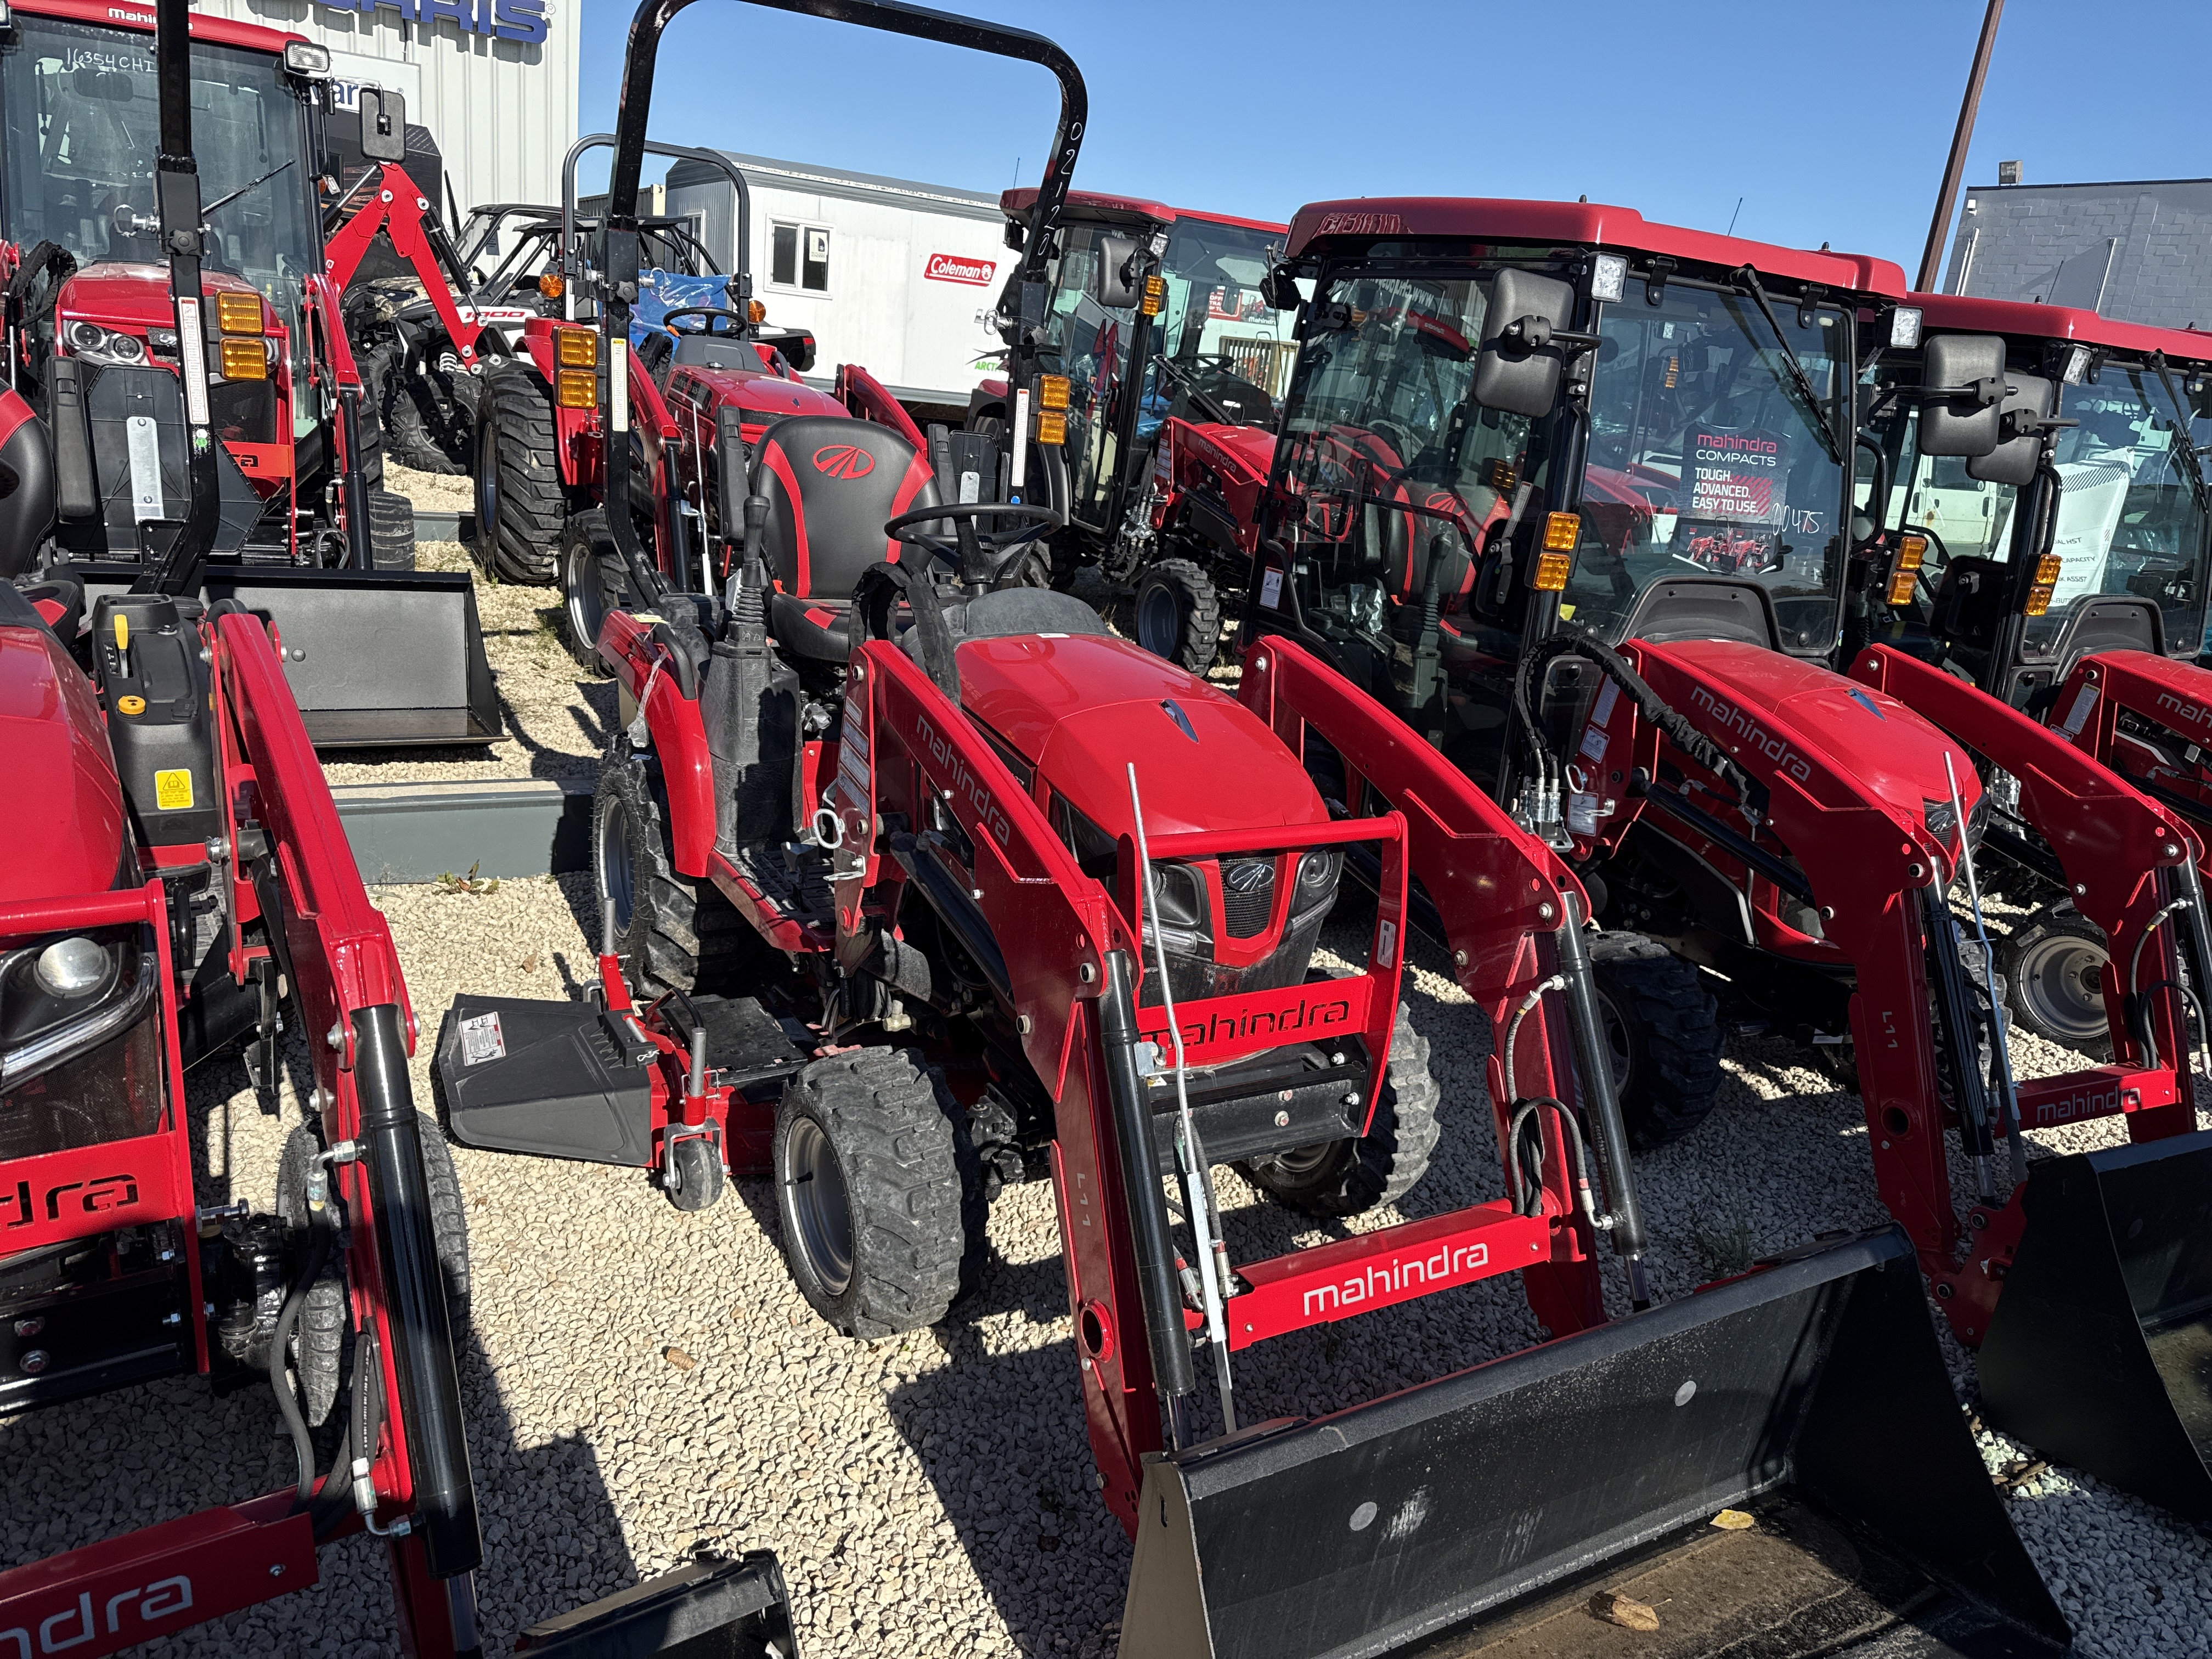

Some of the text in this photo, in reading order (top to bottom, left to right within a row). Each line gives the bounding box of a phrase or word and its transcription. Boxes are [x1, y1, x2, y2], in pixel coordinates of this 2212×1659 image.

[930, 256, 981, 279] Coleman
[1248, 317, 1276, 325] Mahindr
[974, 361, 1001, 372] ARCT
[1198, 439, 1237, 473] mahindra
[1697, 433, 1777, 453] mahindra
[1696, 449, 1776, 466] COMPACTS
[1695, 467, 1733, 482] TOUGH.
[1692, 496, 1758, 513] EASY TO USE.
[1693, 483, 1751, 498] ADVANCED.
[1771, 503, 1824, 536] 00475
[2156, 692, 2212, 729] mah
[1690, 686, 1811, 782] mahindra
[916, 714, 1010, 846] mahindra
[2037, 1086, 2141, 1122] mahindra
[1303, 1243, 1488, 1316] mahindra
[0, 1575, 193, 1659] ndra
